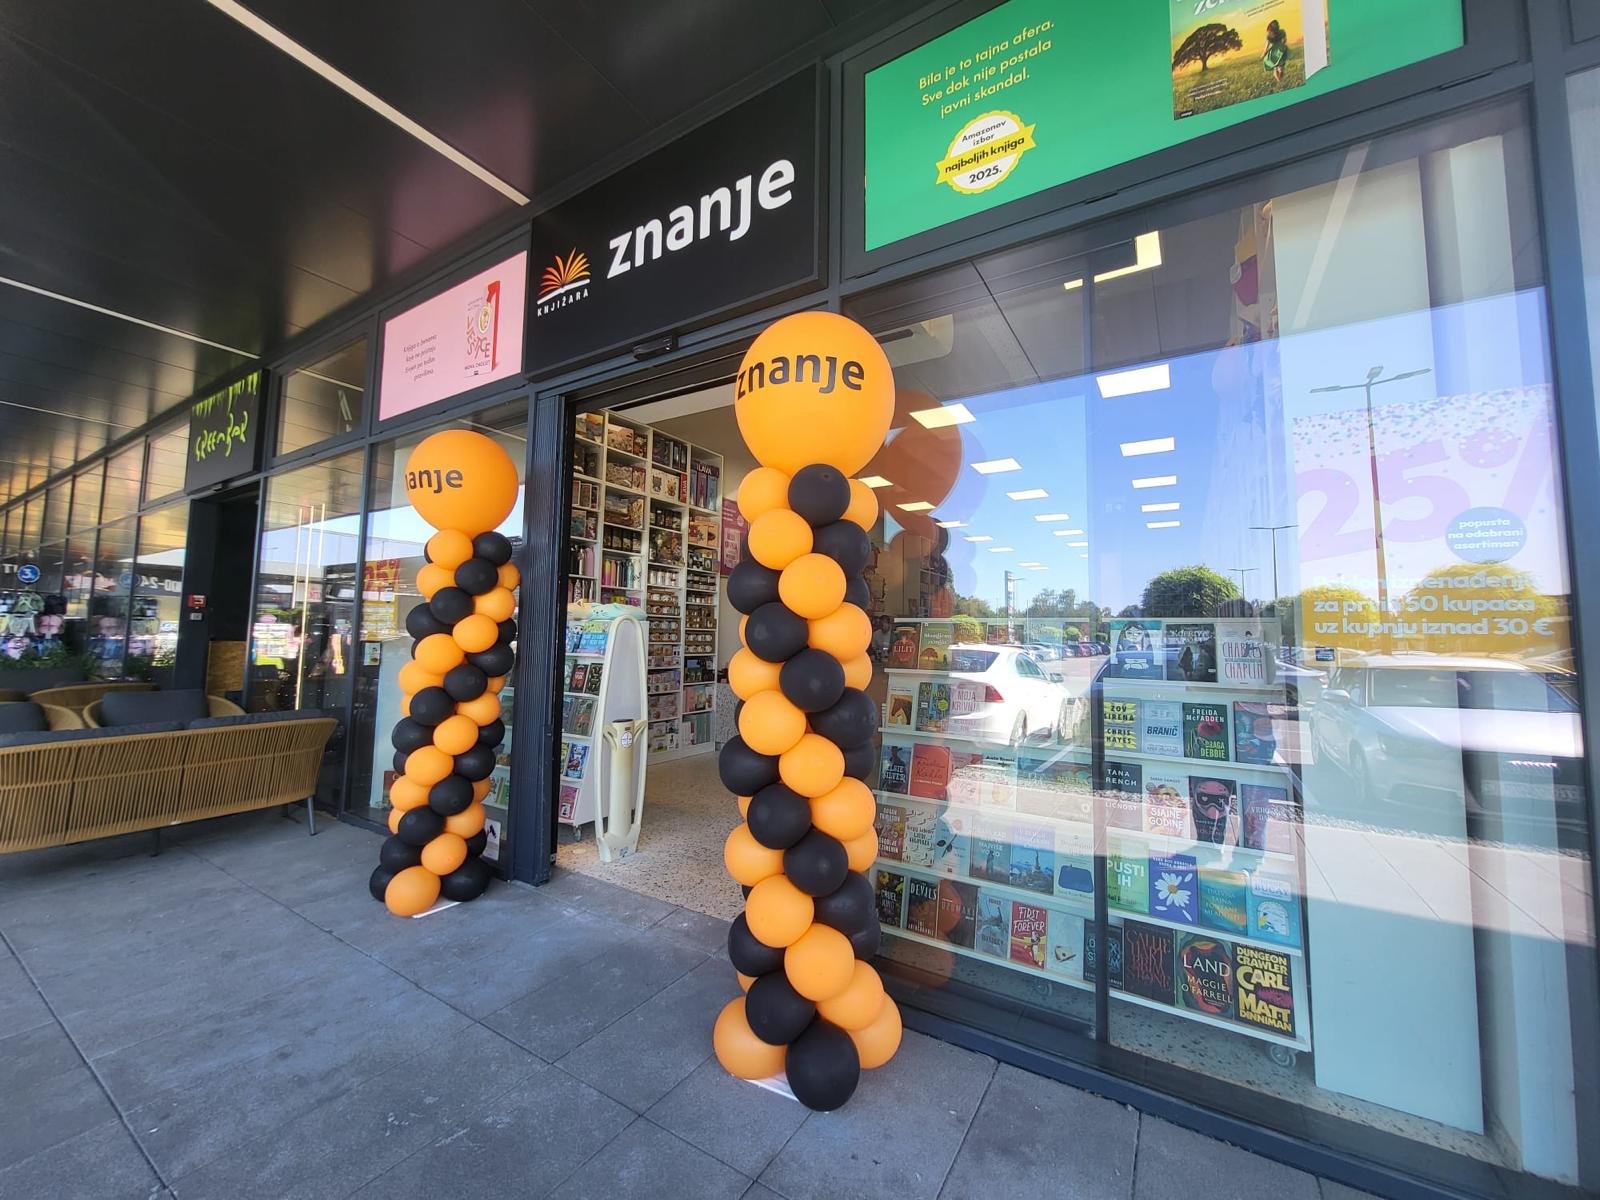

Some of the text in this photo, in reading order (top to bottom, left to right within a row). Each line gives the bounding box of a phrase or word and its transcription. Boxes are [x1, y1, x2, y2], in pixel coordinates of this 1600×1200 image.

[919, 20, 1055, 90] Bila je to tajna afera.
[921, 39, 1052, 107] Sve dok nije postala
[940, 67, 1031, 120] javni skandal.
[961, 119, 1008, 143] Amazonov
[972, 133, 996, 147] izbor
[945, 136, 1026, 174] najboljih knjiga
[968, 164, 1003, 185] 2025.
[607, 159, 795, 280] znanje
[537, 287, 590, 318] KNJIŽARA
[737, 354, 865, 401] znanje
[405, 468, 464, 494] anje
[1458, 518, 1510, 530] popusta
[1448, 528, 1524, 539] na odabrani
[1454, 539, 1520, 550] asortiman
[1314, 600, 1339, 613] za
[1406, 594, 1438, 613] 50
[1443, 594, 1536, 617] kupaca
[1314, 617, 1555, 638] uz kupnju iznad 30 €
[1224, 663, 1264, 679] CHAPLIN
[1104, 712, 1135, 722] SIRENA
[1110, 704, 1128, 713] ZOV
[1191, 707, 1218, 717] FREIDA
[1185, 713, 1225, 723] McFADDEN
[1106, 736, 1132, 745] HAYES
[1107, 728, 1132, 736] CHRIS
[1146, 725, 1178, 738] BRANIČ
[1200, 749, 1227, 759] DEBBIE
[1107, 768, 1130, 778] TANA
[1148, 816, 1184, 831] GODINE
[1107, 860, 1145, 877] PUSTI
[1117, 873, 1132, 887] IH
[910, 882, 937, 901] DEVILS
[1018, 906, 1041, 920] FIRST
[1013, 918, 1046, 935] FOREVER
[1183, 953, 1231, 977] LAND
[1236, 946, 1287, 966] DUNGEON
[1236, 955, 1288, 975] CRAWLER
[1187, 975, 1227, 992] MAGGIE
[1236, 965, 1290, 991] CARL
[1181, 983, 1233, 1004] O'FARRELL
[1238, 987, 1292, 1023] MATT
[1240, 1010, 1293, 1032] DINNIMAN
